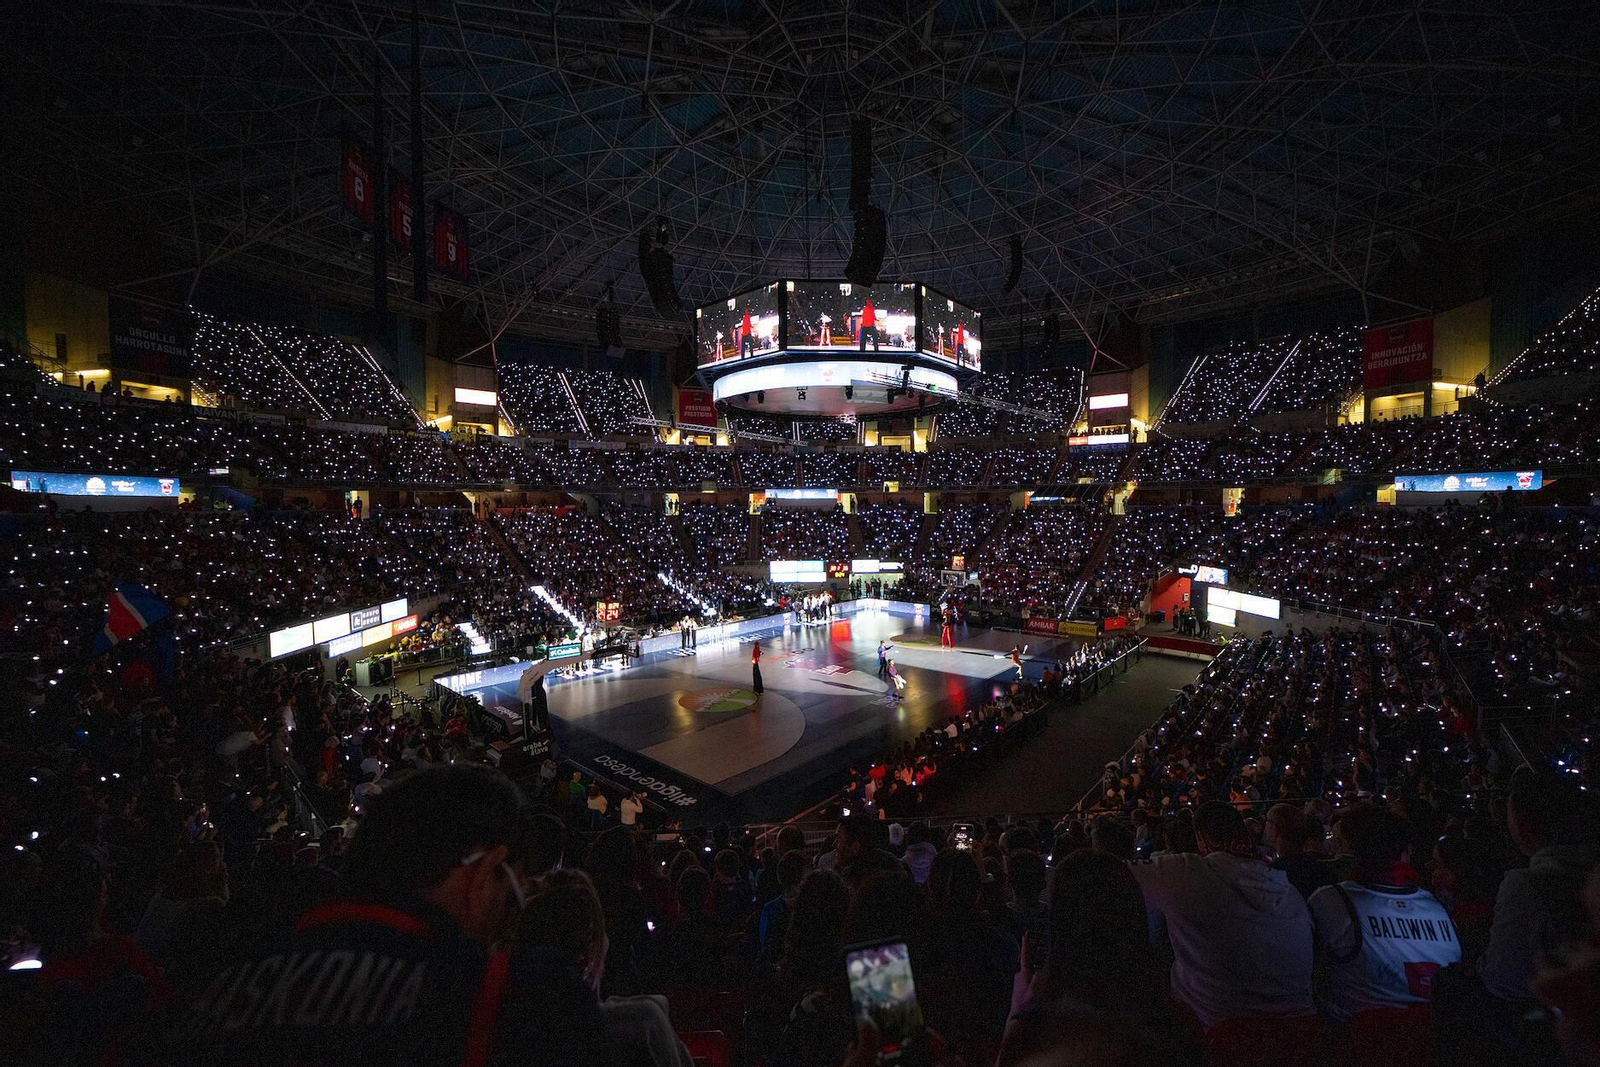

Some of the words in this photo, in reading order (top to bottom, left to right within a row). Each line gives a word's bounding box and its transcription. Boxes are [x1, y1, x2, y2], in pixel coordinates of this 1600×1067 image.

[403, 214, 412, 237] 5
[129, 327, 176, 344] ORGULLO
[115, 335, 188, 357] HARROTASUNA
[1371, 342, 1423, 360] INNOVACIÓN
[1028, 620, 1055, 630] AMBAR
[1367, 915, 1438, 941] BALDWIN
